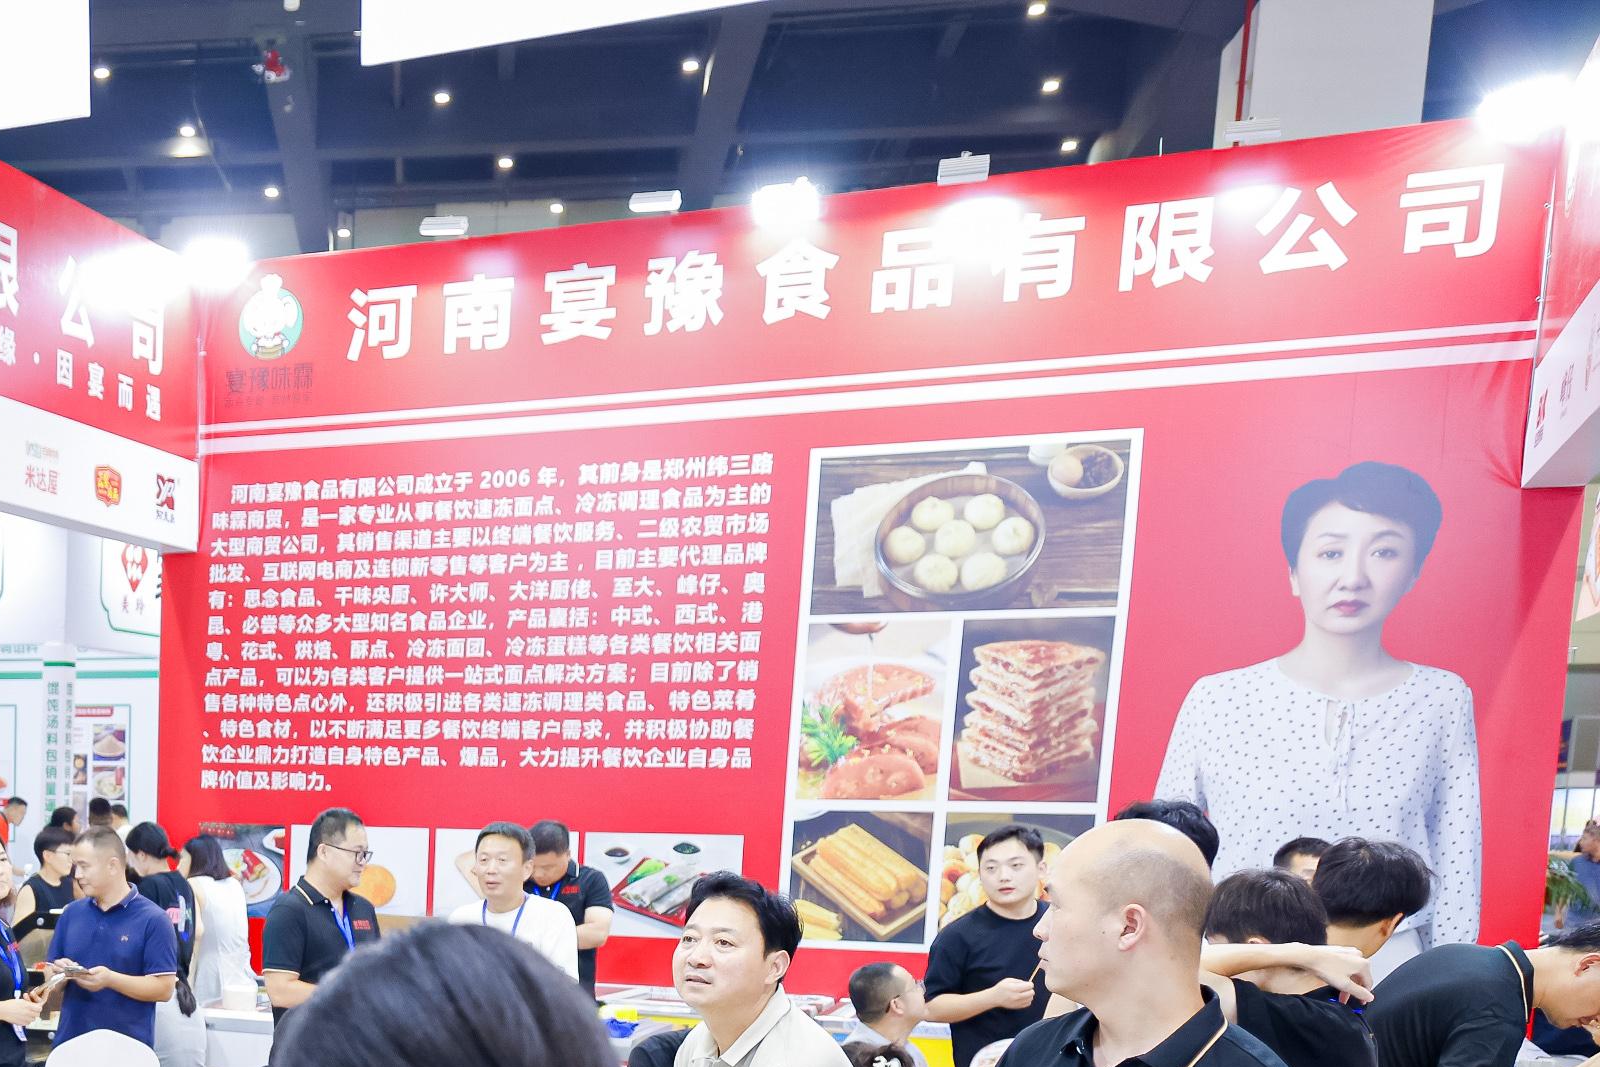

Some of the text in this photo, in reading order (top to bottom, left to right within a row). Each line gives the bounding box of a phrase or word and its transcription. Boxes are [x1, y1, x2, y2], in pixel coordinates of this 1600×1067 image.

[346, 162, 1505, 362] 河南宴豫食品有限公司
[230, 471, 473, 505] 河南宴豫食品有限公司成立于
[479, 468, 531, 490] 2006
[200, 770, 333, 792] 牌价值及影响力。
